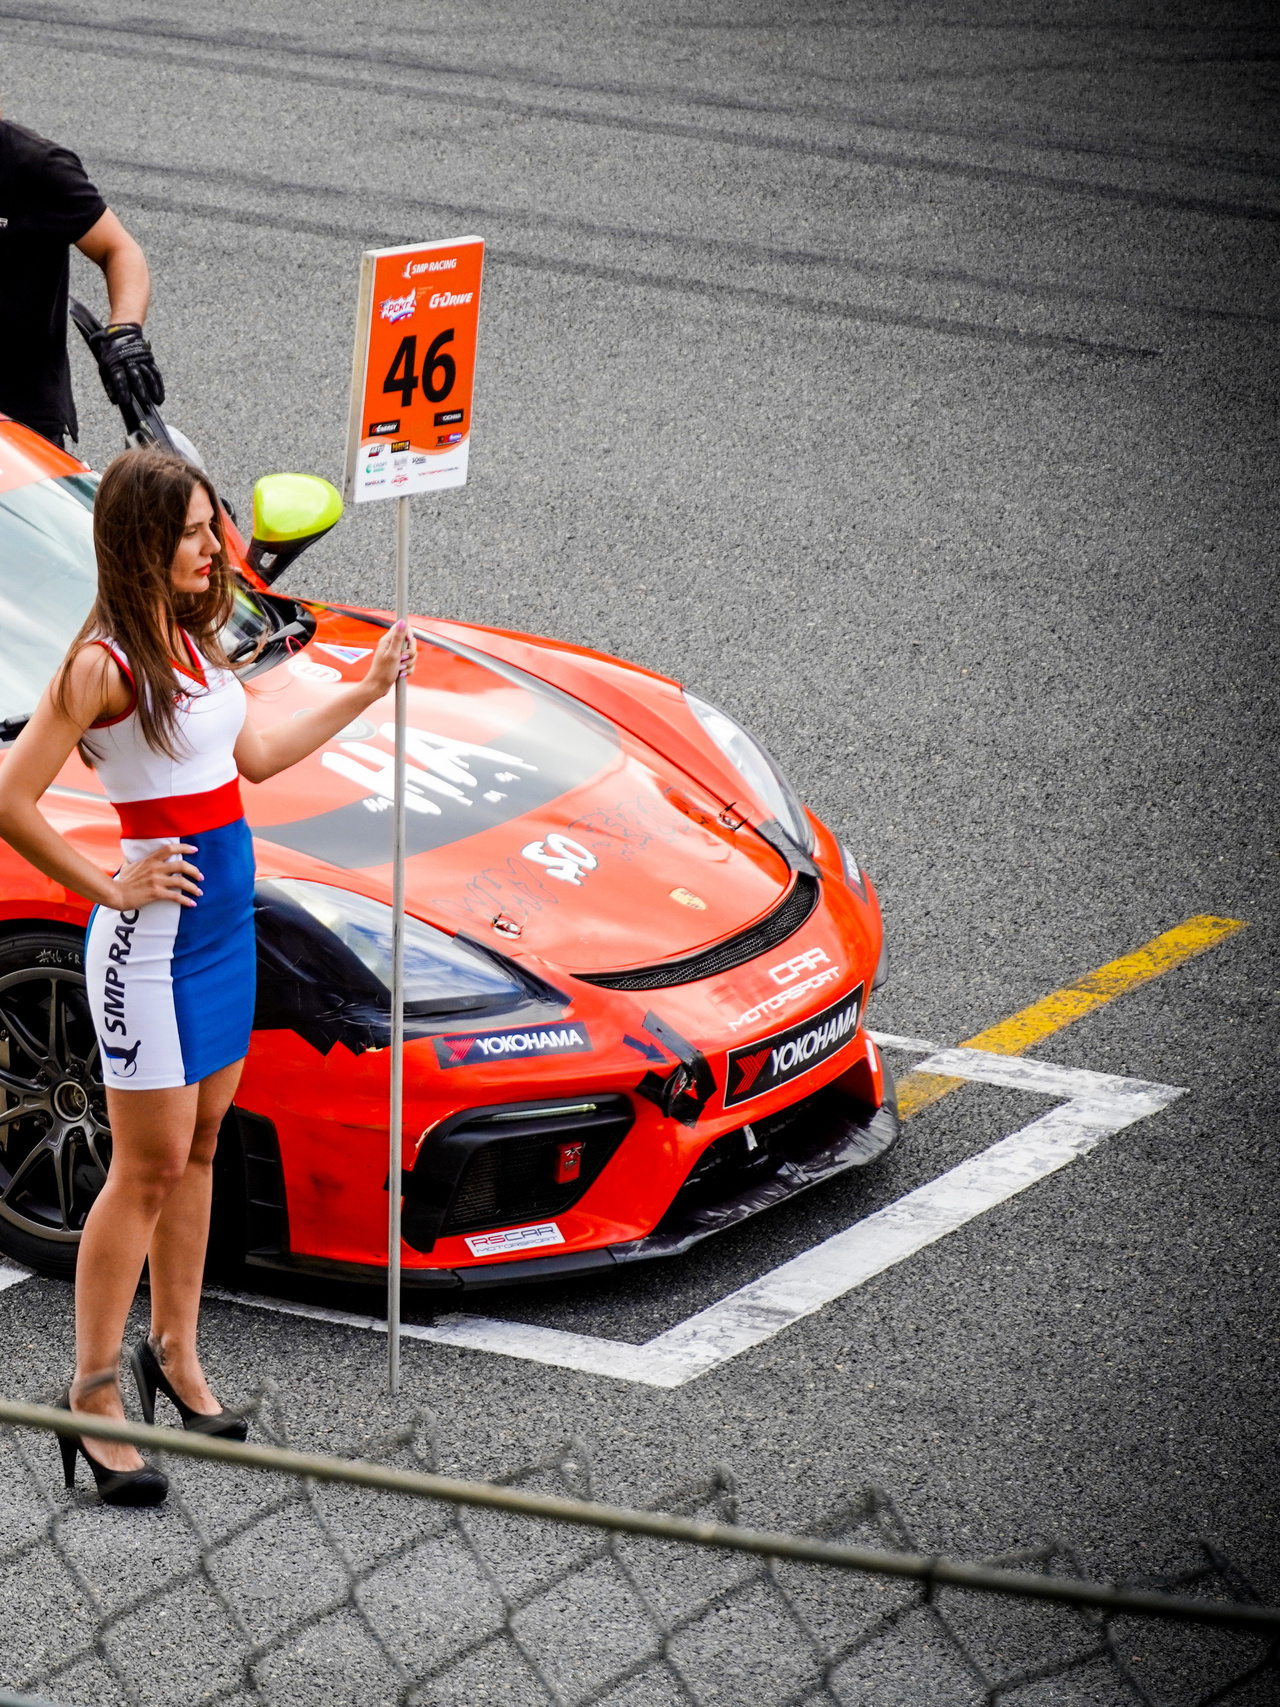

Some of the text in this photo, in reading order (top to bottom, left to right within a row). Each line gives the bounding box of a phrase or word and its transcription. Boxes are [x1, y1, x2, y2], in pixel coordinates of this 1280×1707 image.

[411, 258, 457, 275] SMP RACING
[383, 327, 456, 408] 46
[519, 832, 600, 886] SO
[103, 908, 140, 1037] SMP RAC
[768, 947, 832, 986] CAR
[727, 965, 840, 1032] MOTORSPORT
[475, 1028, 584, 1055] YOKOHAMA
[771, 1001, 858, 1077] YOKOHAMA
[470, 1226, 556, 1247] RSCAR
[476, 1235, 558, 1253] MOTORSPORT
